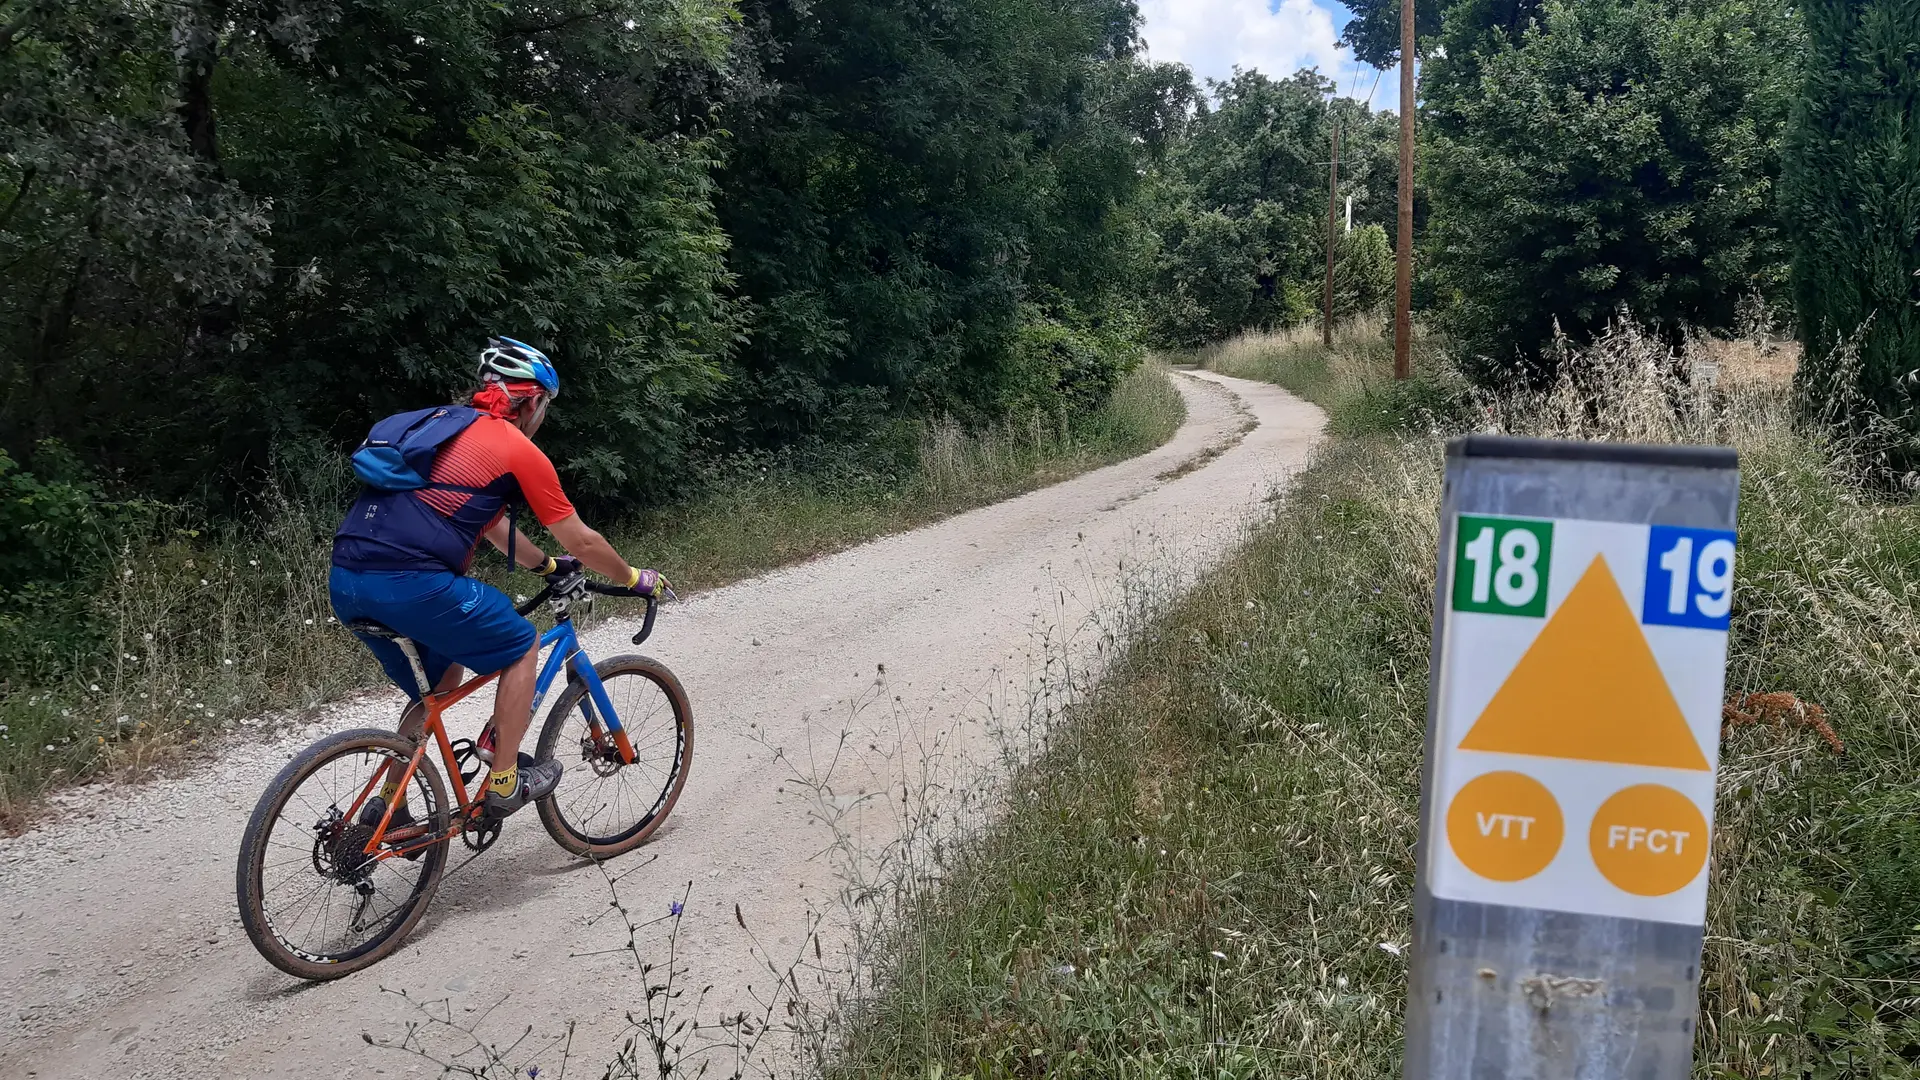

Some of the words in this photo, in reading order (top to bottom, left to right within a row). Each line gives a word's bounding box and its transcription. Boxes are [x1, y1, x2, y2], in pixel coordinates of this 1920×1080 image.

[1465, 526, 1540, 607] 18
[1660, 536, 1736, 618] 19
[1476, 811, 1536, 839] VTT
[1607, 825, 1690, 855] FFCT
